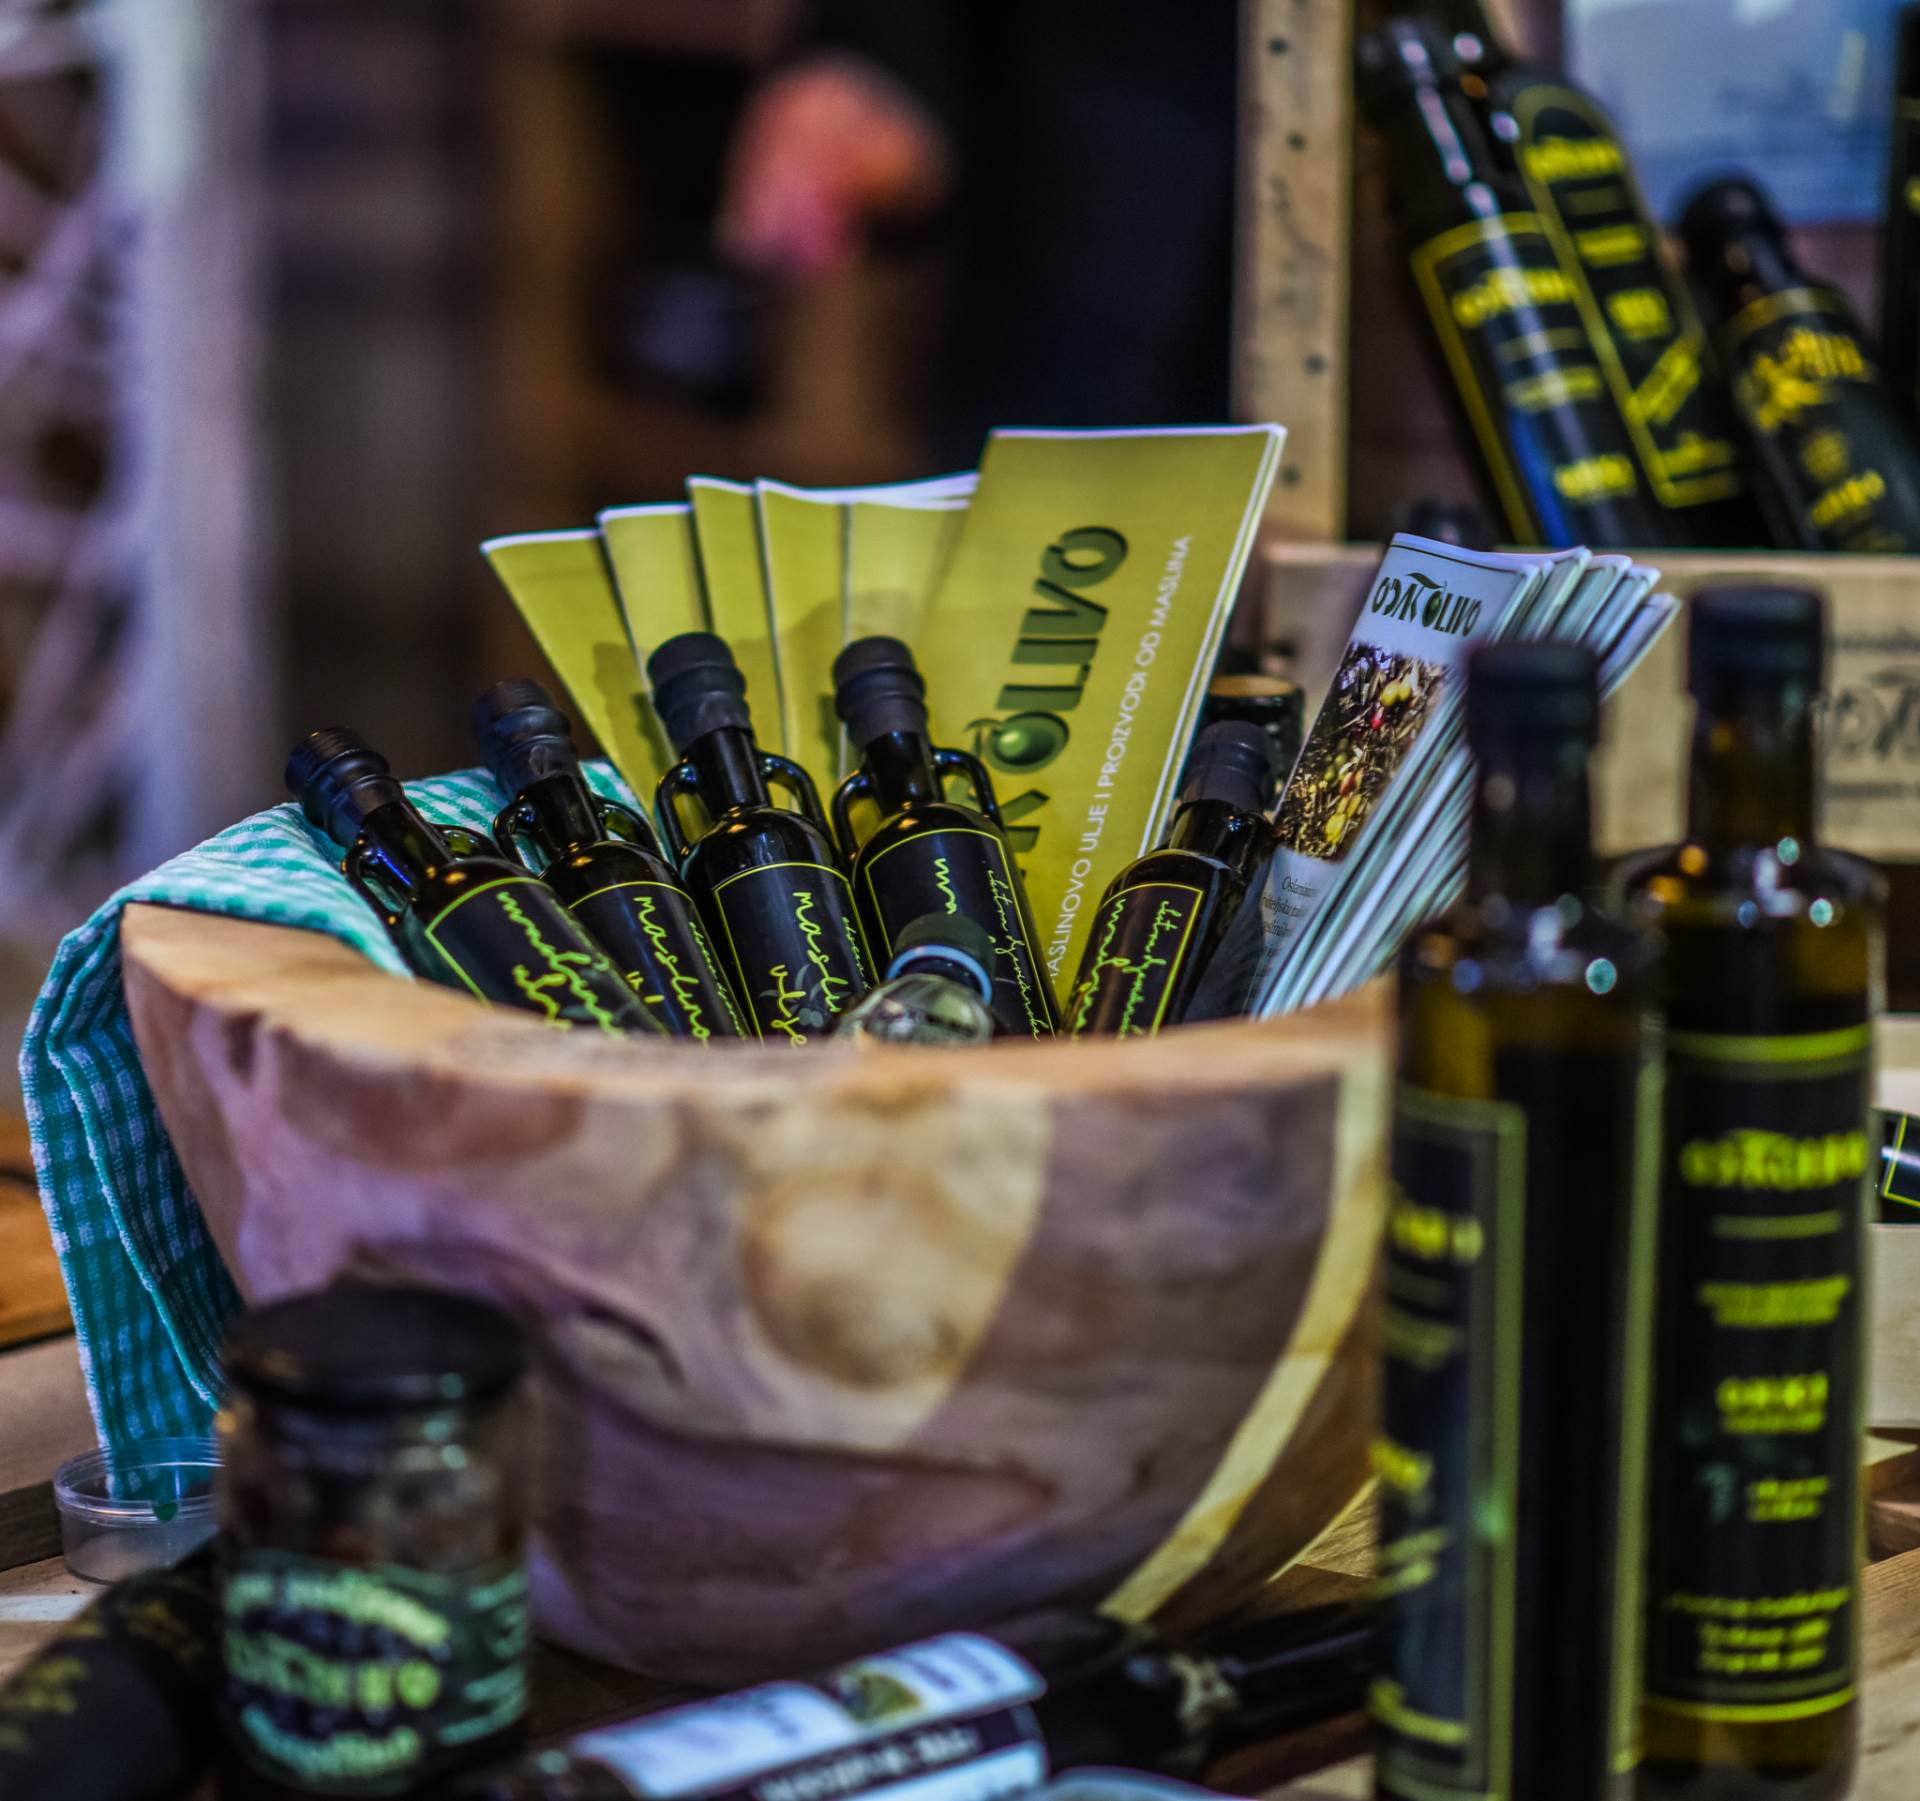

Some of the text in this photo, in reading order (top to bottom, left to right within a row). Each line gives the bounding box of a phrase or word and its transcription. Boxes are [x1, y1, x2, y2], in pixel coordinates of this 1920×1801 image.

[985, 525, 1128, 774] OLIVO
[1077, 804, 1109, 852] ULJE
[1097, 671, 1148, 787] PROIZVODI
[1135, 631, 1160, 666] OD
[1149, 535, 1192, 628] MASLINA
[1421, 589, 1482, 637] OLIVO
